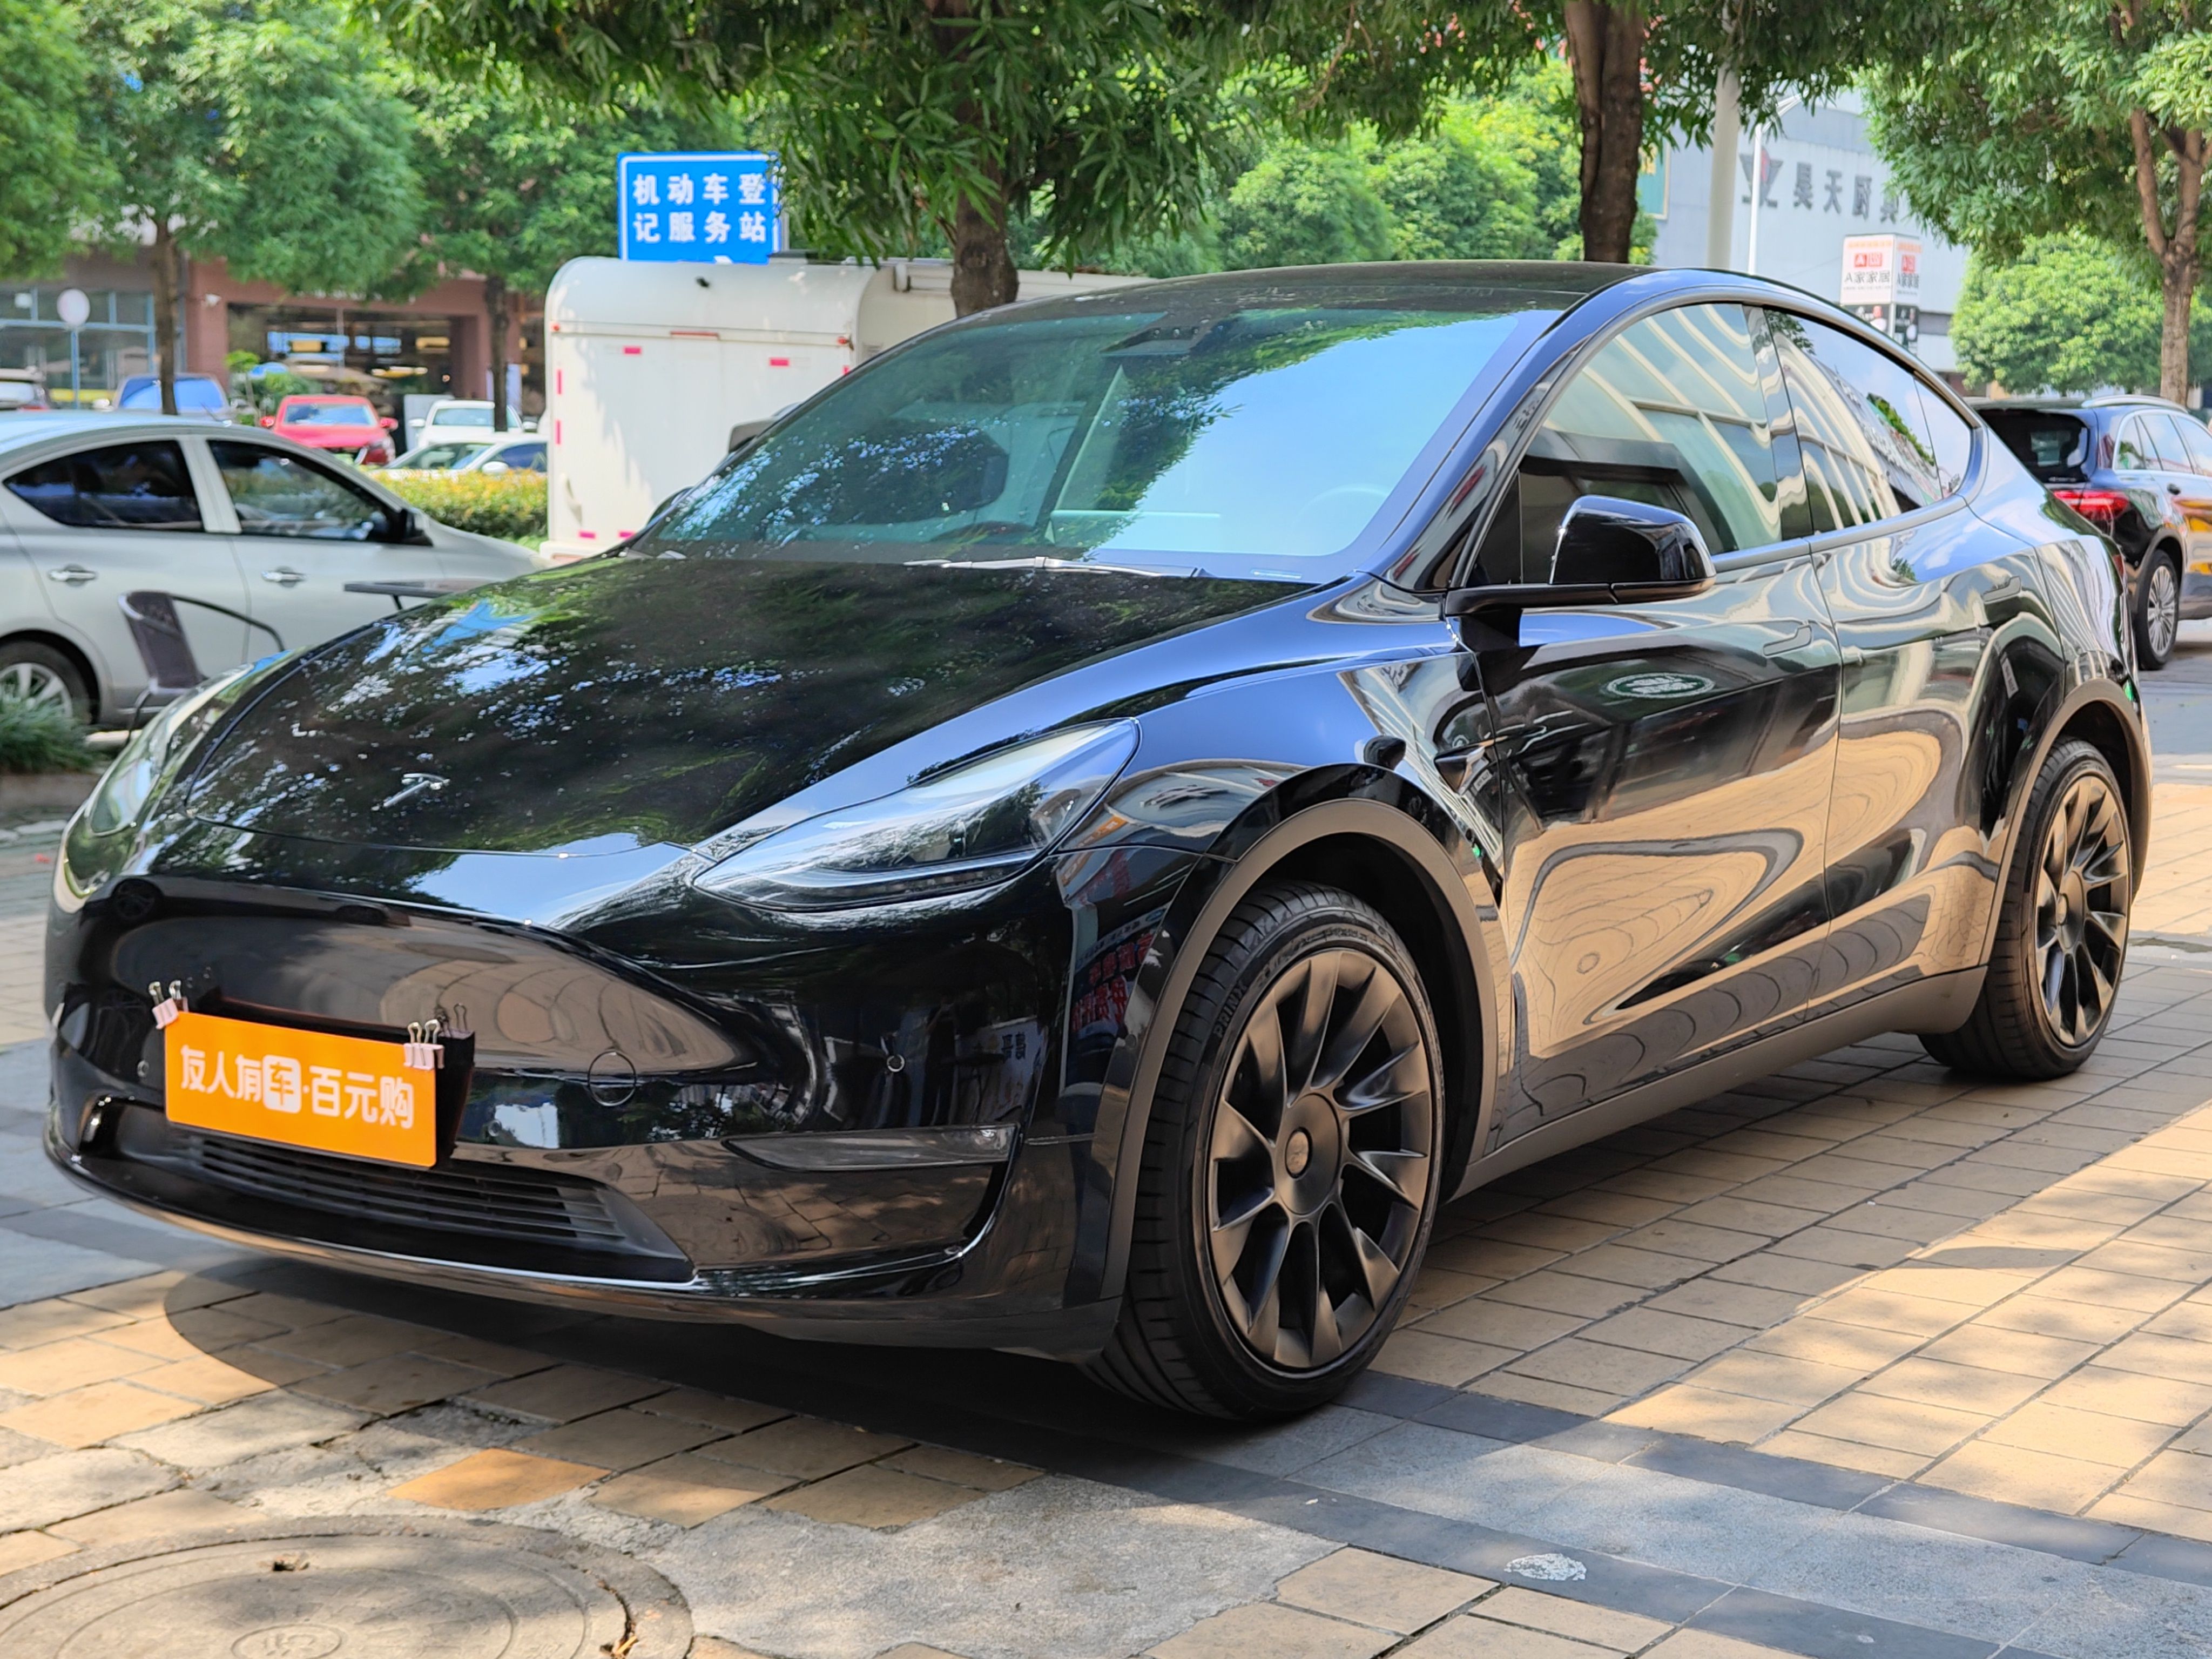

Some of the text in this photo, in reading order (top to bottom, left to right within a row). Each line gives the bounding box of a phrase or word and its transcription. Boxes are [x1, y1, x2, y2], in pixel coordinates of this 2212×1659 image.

[633, 173, 765, 205] 机动车登
[633, 211, 766, 242] 记服务站
[1845, 271, 1890, 284] A家家居
[1213, 980, 1247, 1038] PRINX
